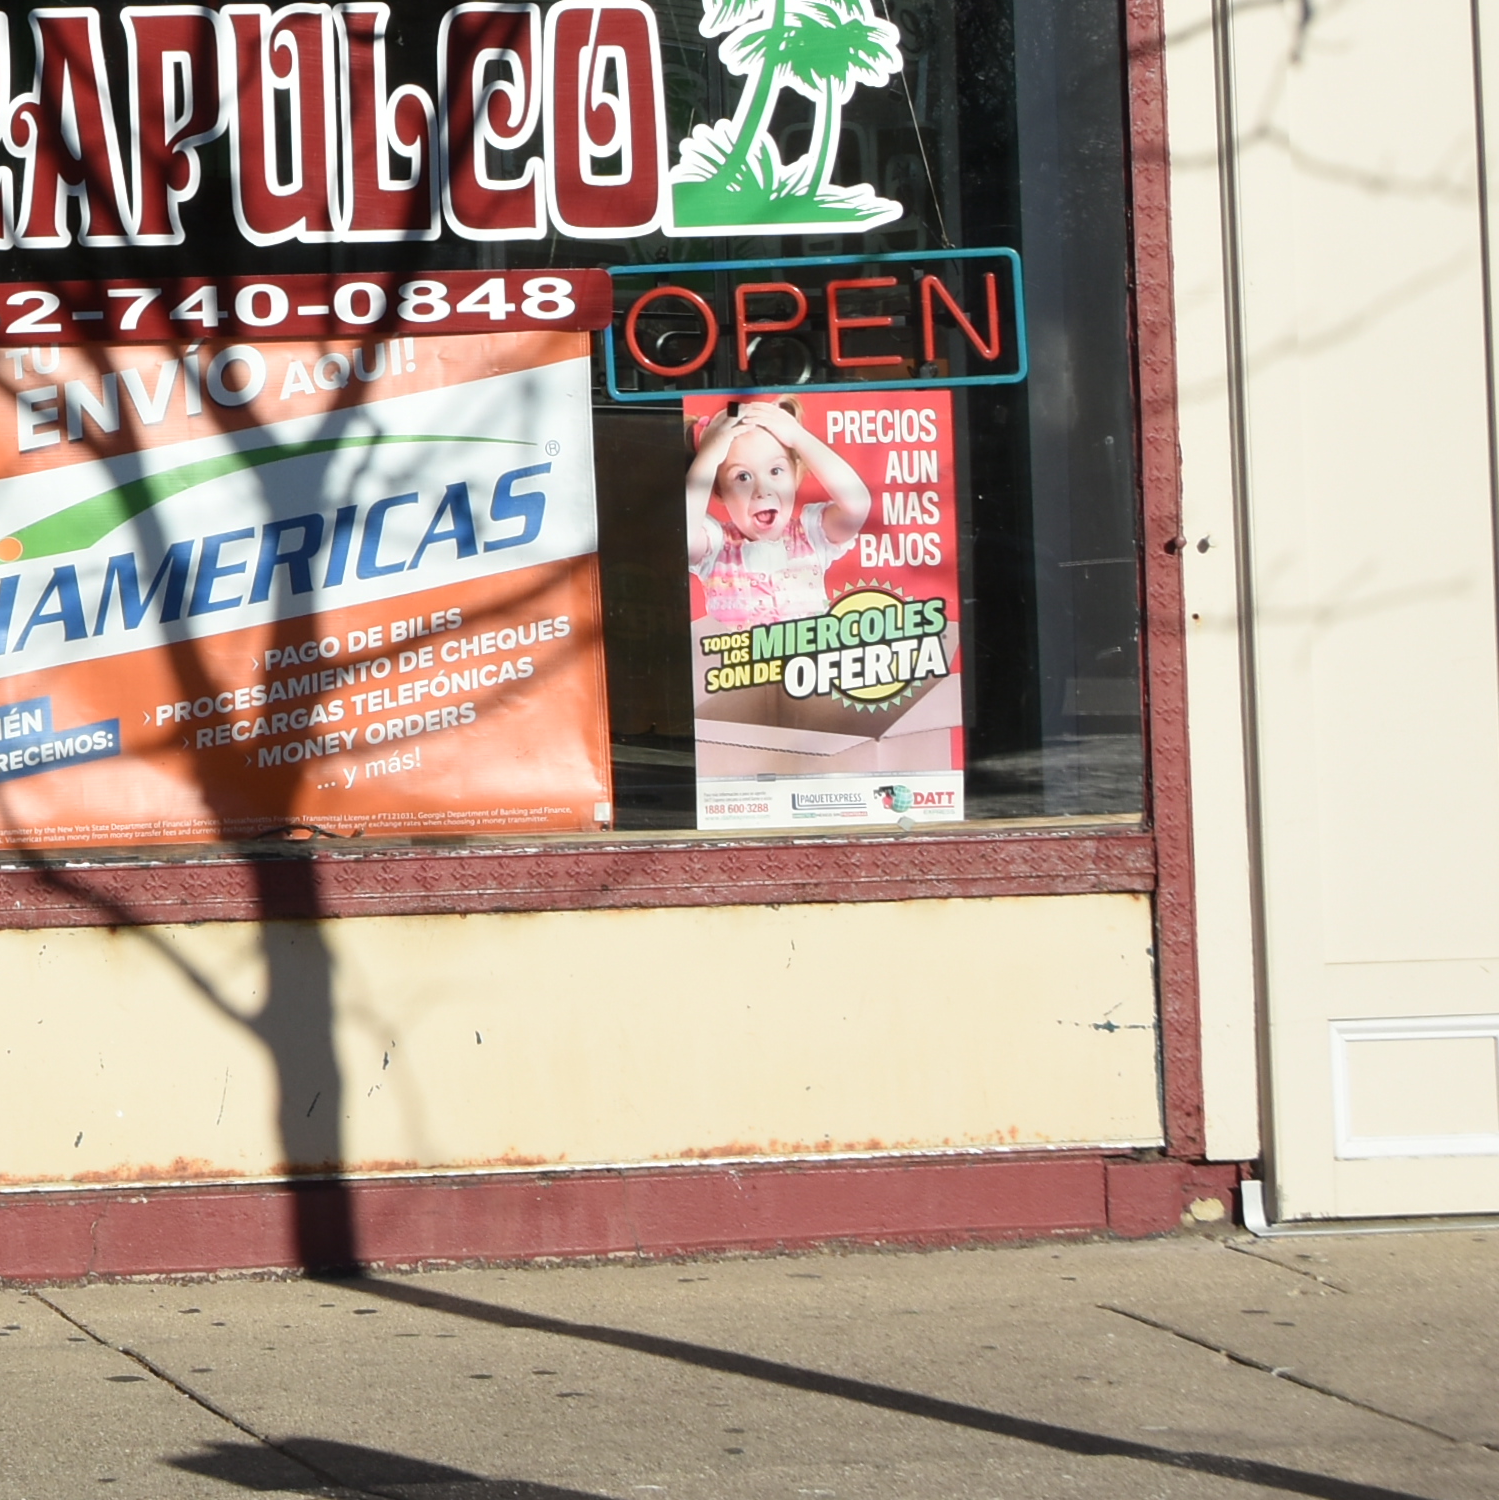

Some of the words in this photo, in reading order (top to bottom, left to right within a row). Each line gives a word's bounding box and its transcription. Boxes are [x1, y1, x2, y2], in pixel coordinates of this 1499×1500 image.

[624, 272, 1001, 377] OPEN
[5, 343, 61, 380] TU
[15, 338, 267, 453] ENVÍO
[278, 334, 417, 400] AQUÍ!
[826, 410, 937, 444] PRECIOS
[885, 451, 938, 483] AUN
[882, 492, 940, 526] MAS
[859, 532, 942, 569] BAJOS
[263, 637, 341, 671] PAGO
[347, 626, 383, 653] DE
[390, 607, 463, 643] BILES
[702, 632, 750, 653] TODOS
[752, 599, 945, 661] MIERCOLES
[155, 657, 392, 728] PROCESAMIENTO
[398, 647, 434, 674] DE
[440, 615, 571, 663] CHEQUES
[723, 647, 750, 666] LOS
[784, 635, 947, 698] OFERTA
[706, 665, 751, 692] SON
[753, 660, 782, 684] DE
[196, 700, 345, 750] RECARGAS
[350, 656, 534, 717] TELEFÓNICAS
[257, 728, 359, 769] MONEY
[364, 702, 477, 745] ORDERS
[342, 765, 359, 790] y
[365, 747, 422, 779] más!
[800, 793, 862, 804] PAQUETEXPRESS
[913, 791, 955, 805] DATT
